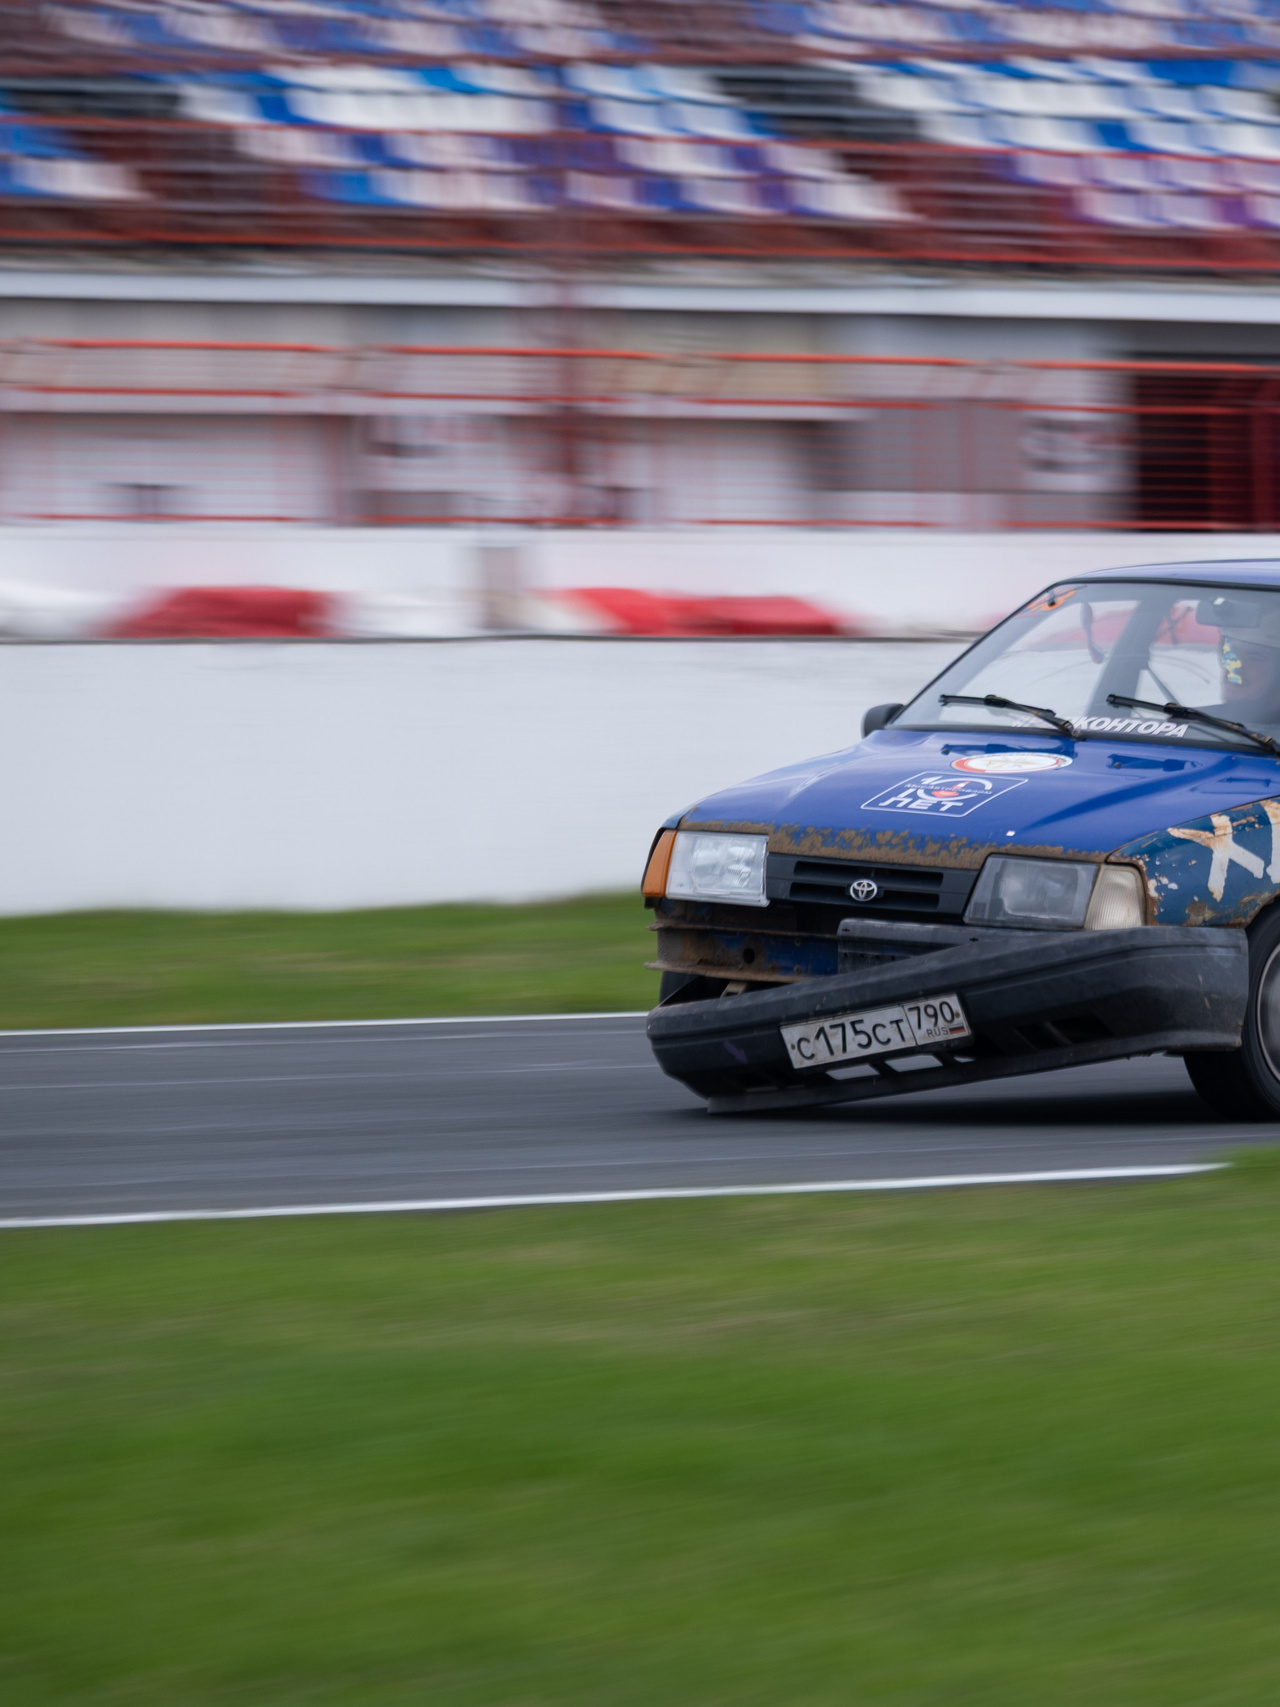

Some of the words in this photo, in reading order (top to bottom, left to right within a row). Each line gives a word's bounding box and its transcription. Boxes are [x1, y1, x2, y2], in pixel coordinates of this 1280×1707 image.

[878, 795, 965, 812] ЛЕТ
[797, 1019, 906, 1061] С175СТ
[908, 1001, 956, 1030] 790
[926, 1027, 949, 1038] RUS
